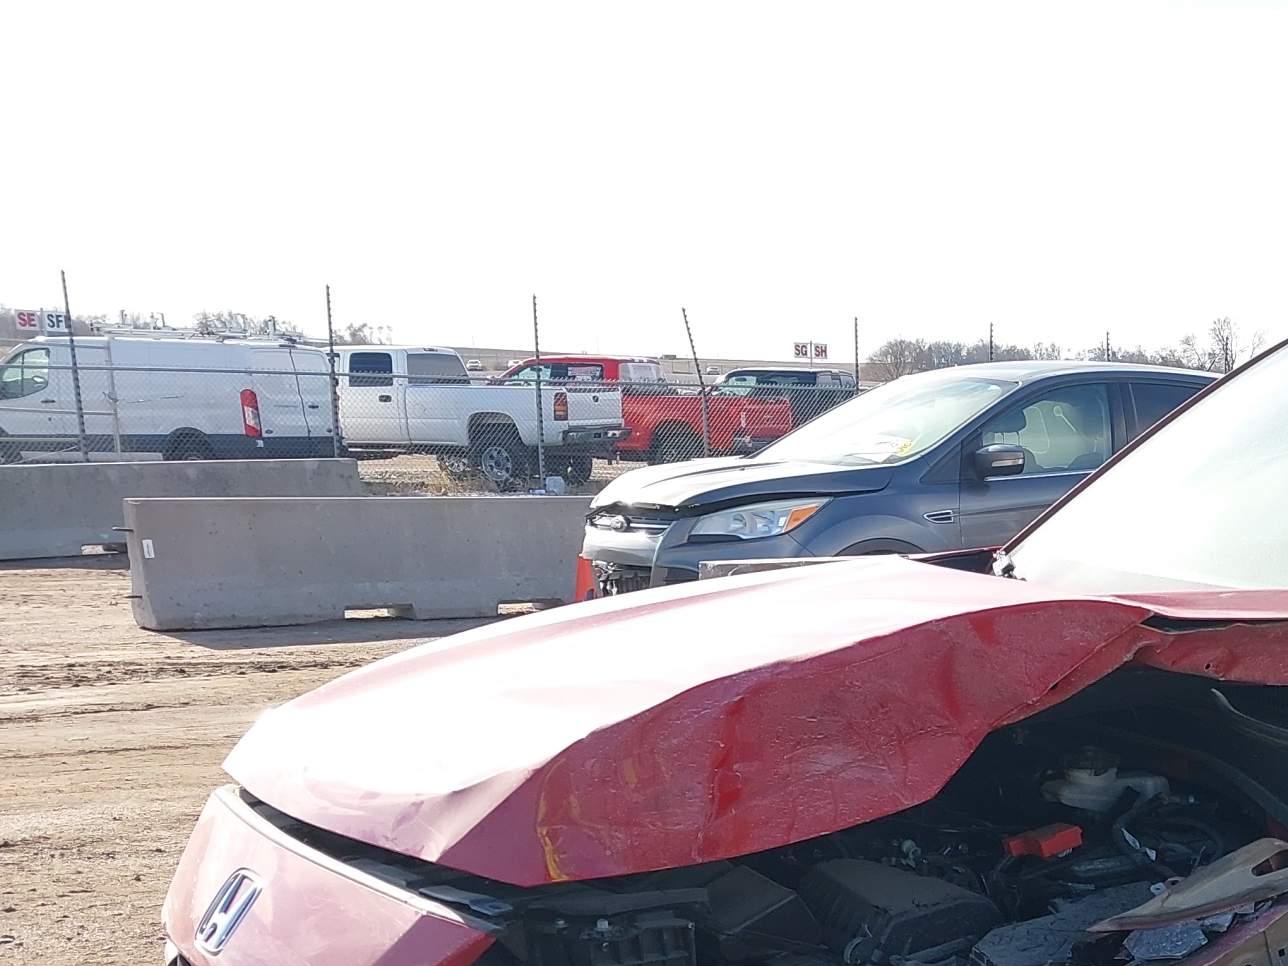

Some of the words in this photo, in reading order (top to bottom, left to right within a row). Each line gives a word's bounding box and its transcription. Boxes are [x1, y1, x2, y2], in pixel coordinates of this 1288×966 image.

[17, 312, 37, 327] SE
[46, 313, 63, 328] SF
[794, 344, 808, 356] SG
[814, 345, 827, 357] SH
